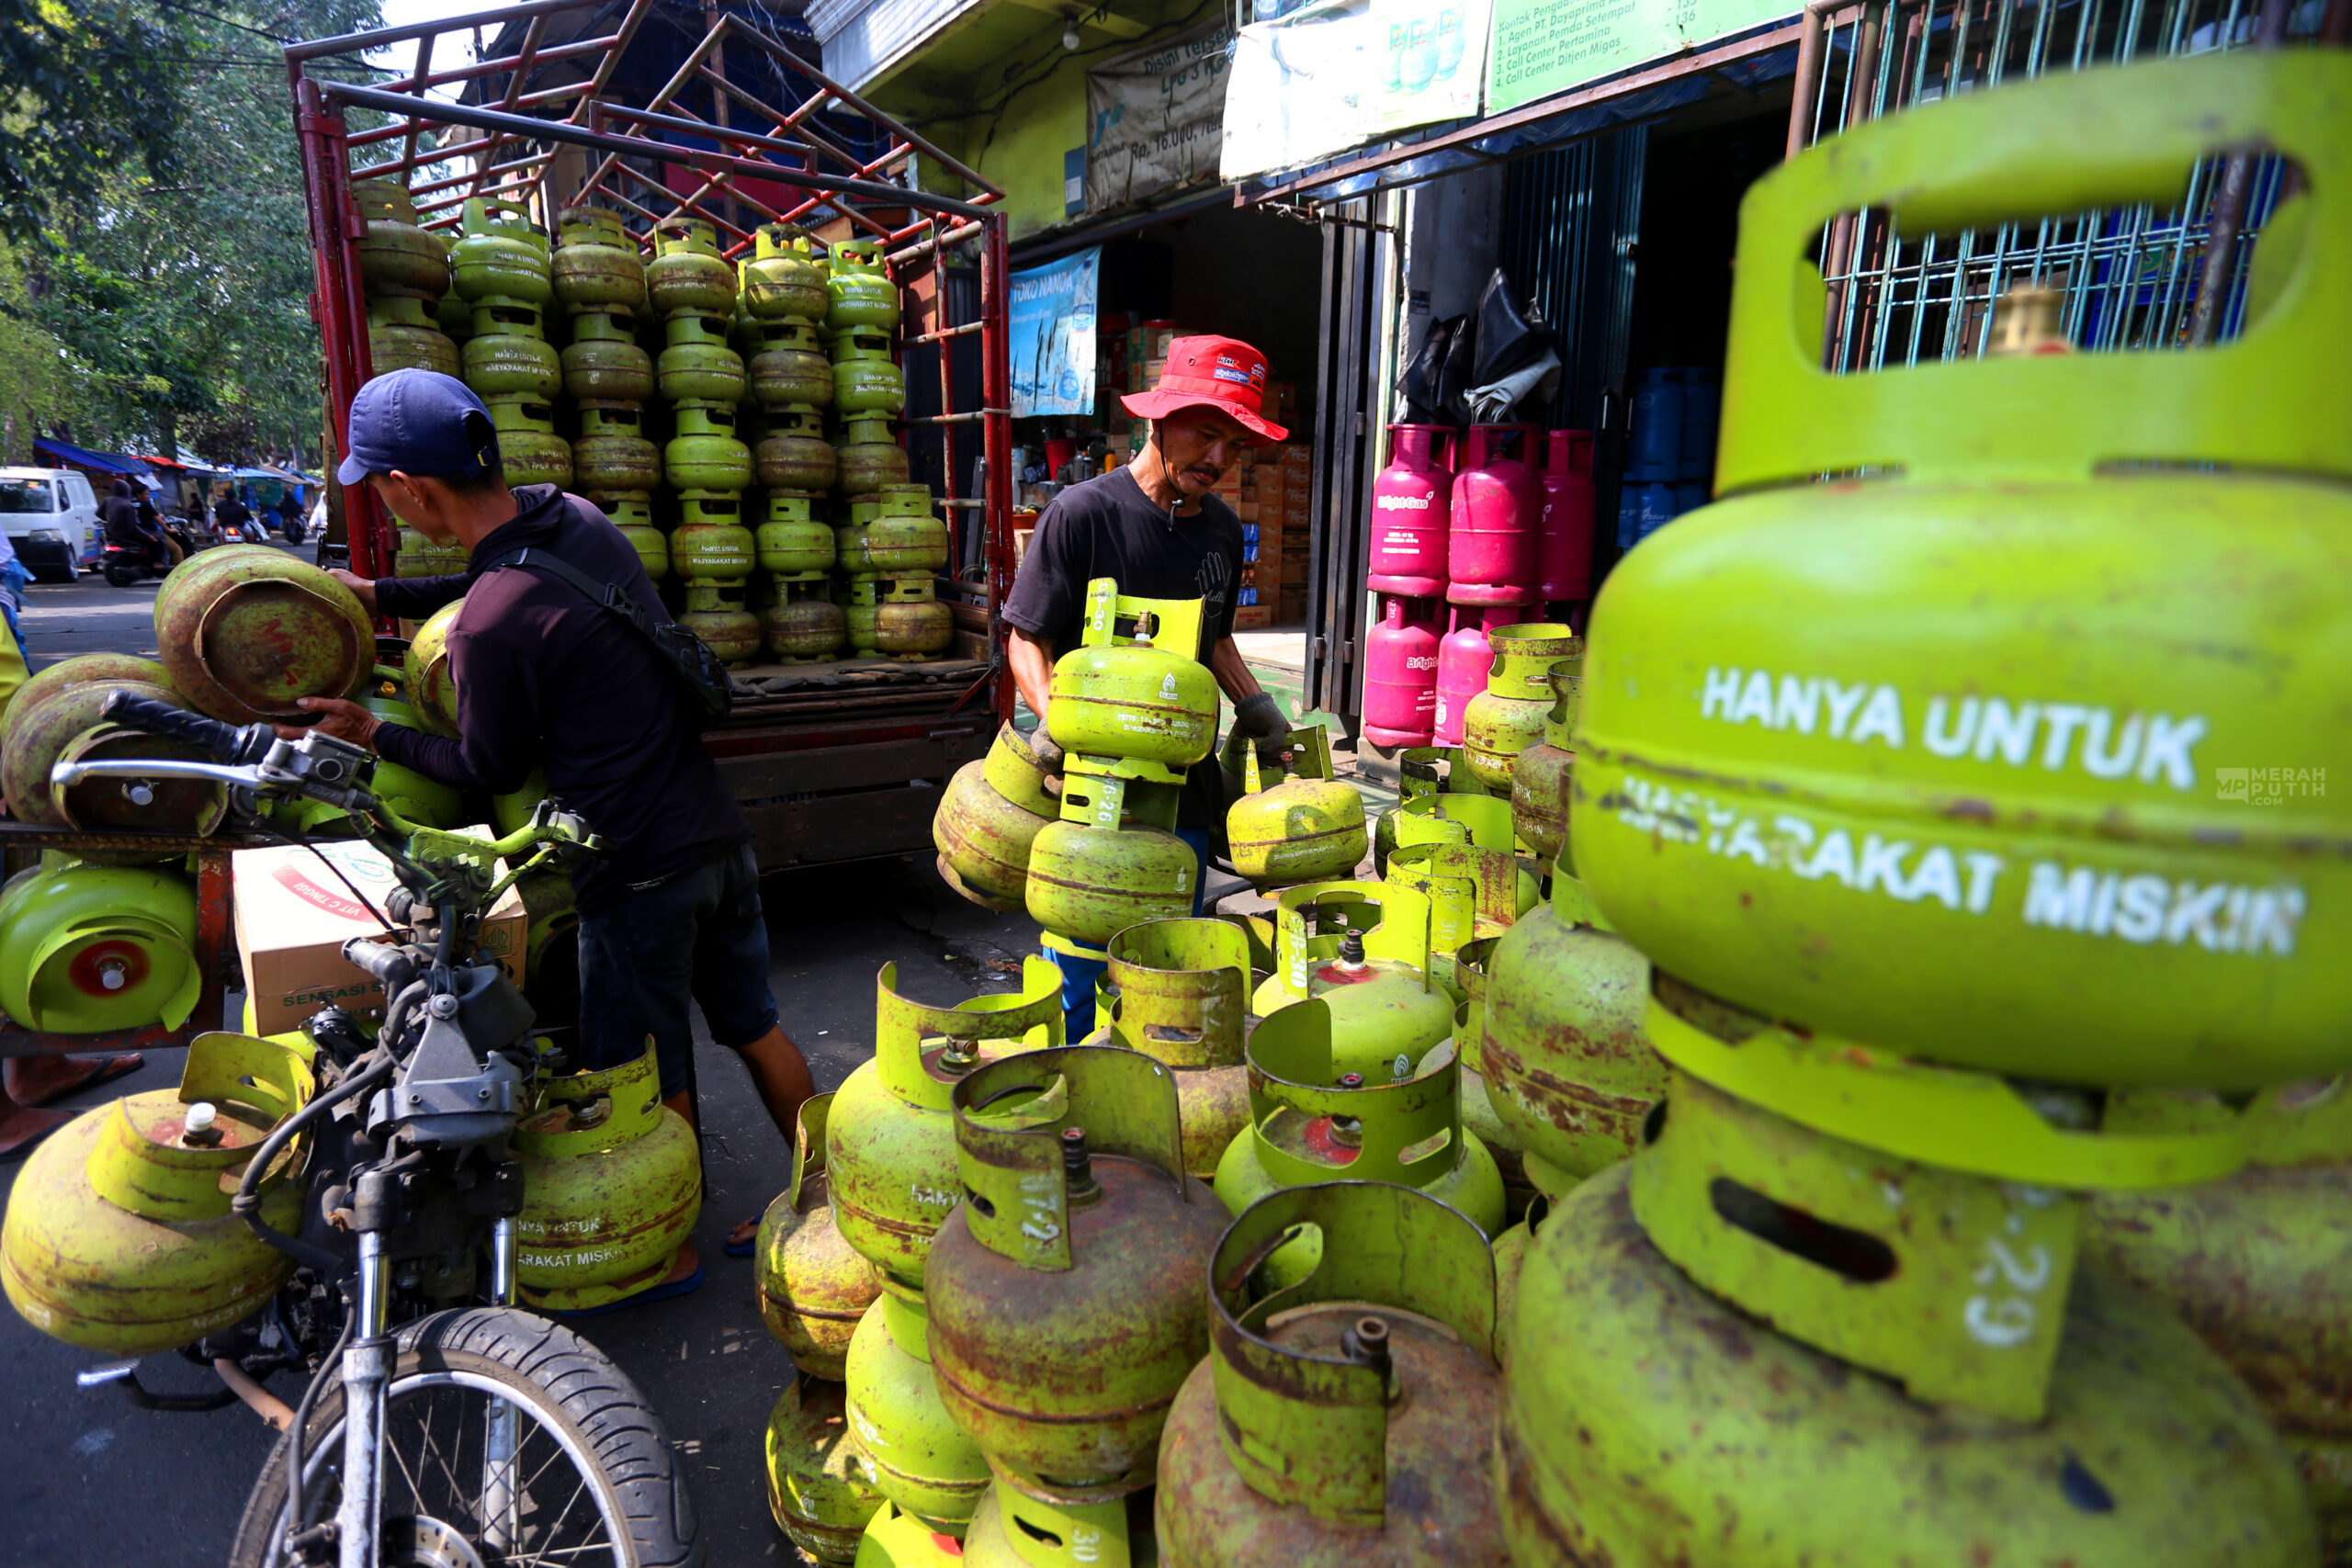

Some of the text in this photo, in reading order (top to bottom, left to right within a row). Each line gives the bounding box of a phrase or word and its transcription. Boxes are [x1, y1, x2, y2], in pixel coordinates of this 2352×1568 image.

[1498, 10, 1532, 32] Kontak
[1508, 26, 1532, 43] Agen
[1534, 18, 1547, 31] PT.
[1550, 0, 1605, 27] Dayaprima
[1508, 35, 1546, 57] Layanan
[1549, 22, 1582, 42] Pemda
[1586, 2, 1635, 28] Setempat
[1144, 25, 1235, 74] Disini Tersed
[1506, 68, 1522, 85] Call
[1525, 58, 1555, 78] Center
[1558, 48, 1587, 65] Ditjen
[1589, 37, 1622, 55] Migas
[1676, 9, 1696, 27] 136
[1507, 54, 1523, 71] Call
[1526, 44, 1555, 63] Center
[1559, 26, 1611, 50] Pertamina
[1161, 73, 1187, 94] LPG
[1013, 271, 1073, 303] TOKO NANDA
[1406, 496, 1430, 510] Gas
[1407, 656, 1438, 671] Bright
[1699, 666, 2208, 791] HANYA UNTUK
[293, 882, 361, 917] VIT C TINGGI
[2022, 859, 2309, 957] MISKIN
[283, 984, 367, 1007] SENSASI
[518, 1219, 546, 1235] NYA
[1071, 1529, 1100, 1562] 30
